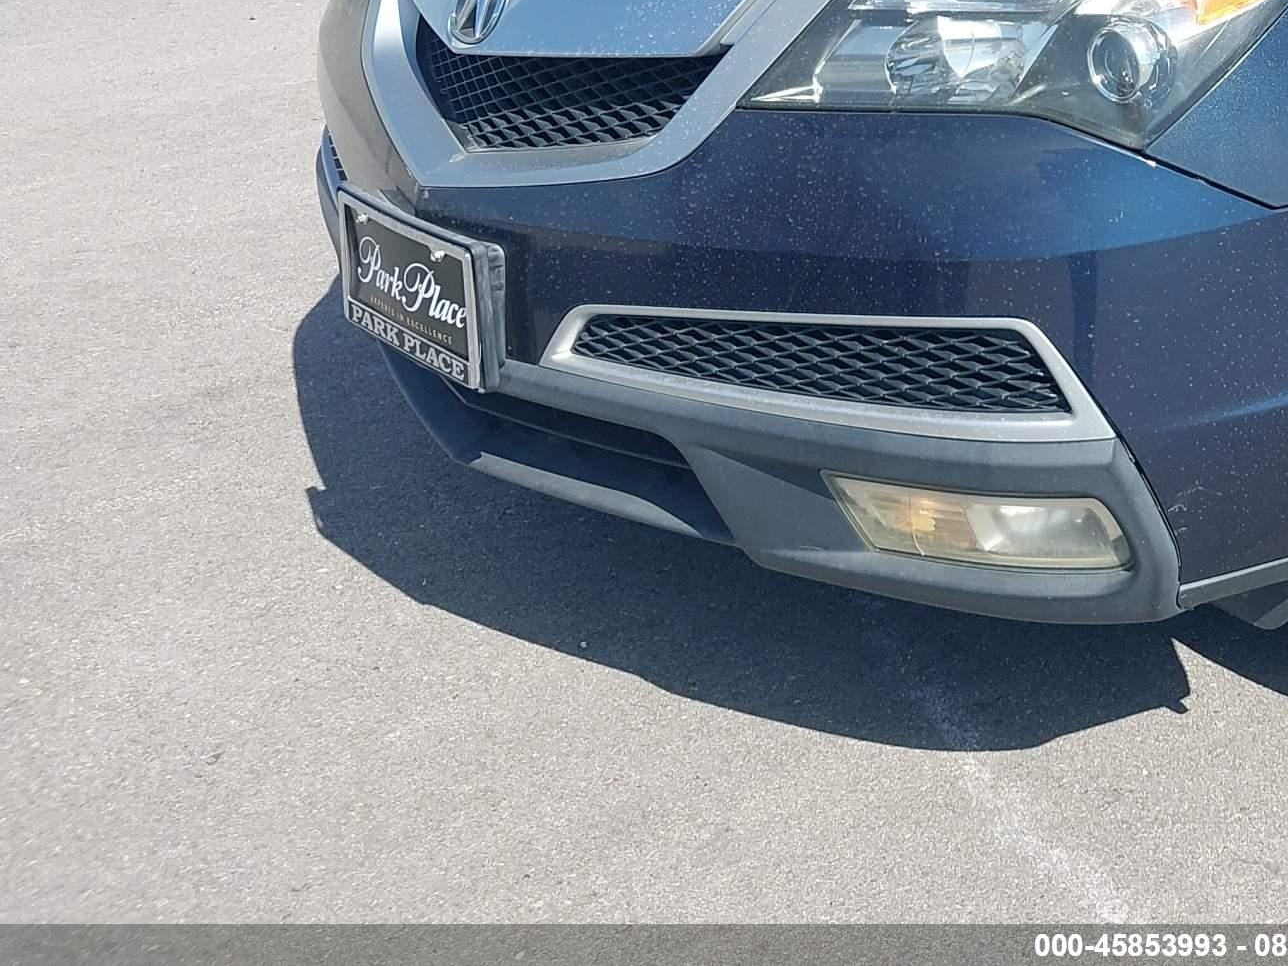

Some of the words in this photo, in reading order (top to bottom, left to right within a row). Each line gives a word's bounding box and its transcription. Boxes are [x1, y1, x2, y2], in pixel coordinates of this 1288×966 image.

[357, 236, 403, 301] Park
[401, 262, 467, 329] Place
[351, 304, 400, 346] PARK
[403, 332, 465, 380] PLACE
[406, 317, 453, 345] EXCELLENCE
